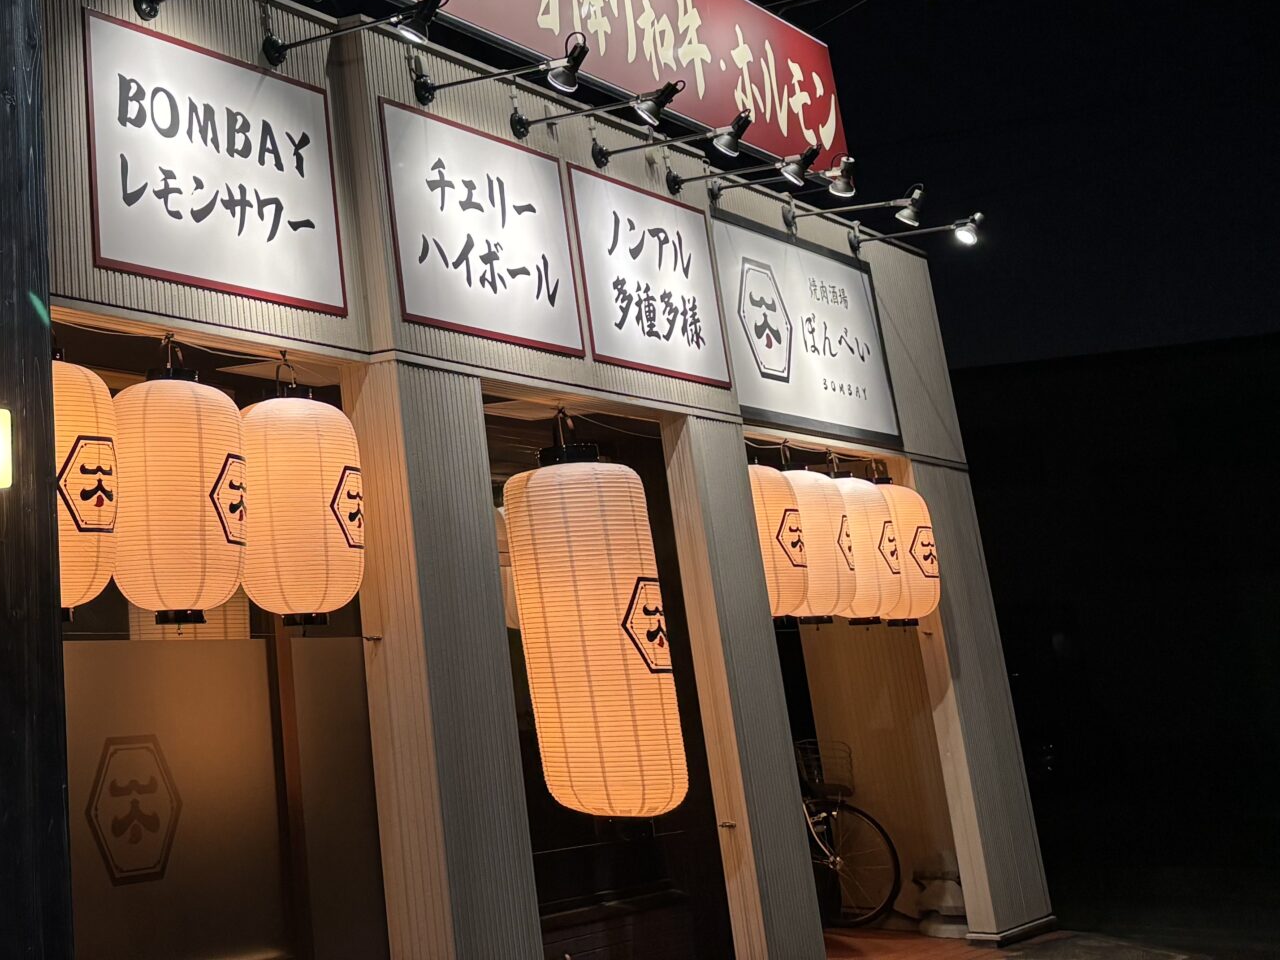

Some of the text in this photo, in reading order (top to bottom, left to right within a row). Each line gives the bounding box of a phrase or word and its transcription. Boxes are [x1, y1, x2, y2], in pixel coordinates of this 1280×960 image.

[116, 73, 312, 179] BOMBAY
[119, 153, 317, 243] レモンサワー
[425, 157, 538, 229] チェリー
[418, 232, 559, 308] ハイボール
[607, 210, 692, 280] ノンアル
[612, 275, 706, 351] 多種多様
[808, 277, 849, 310] 焼肉酒場
[800, 312, 871, 363] ぼんべい
